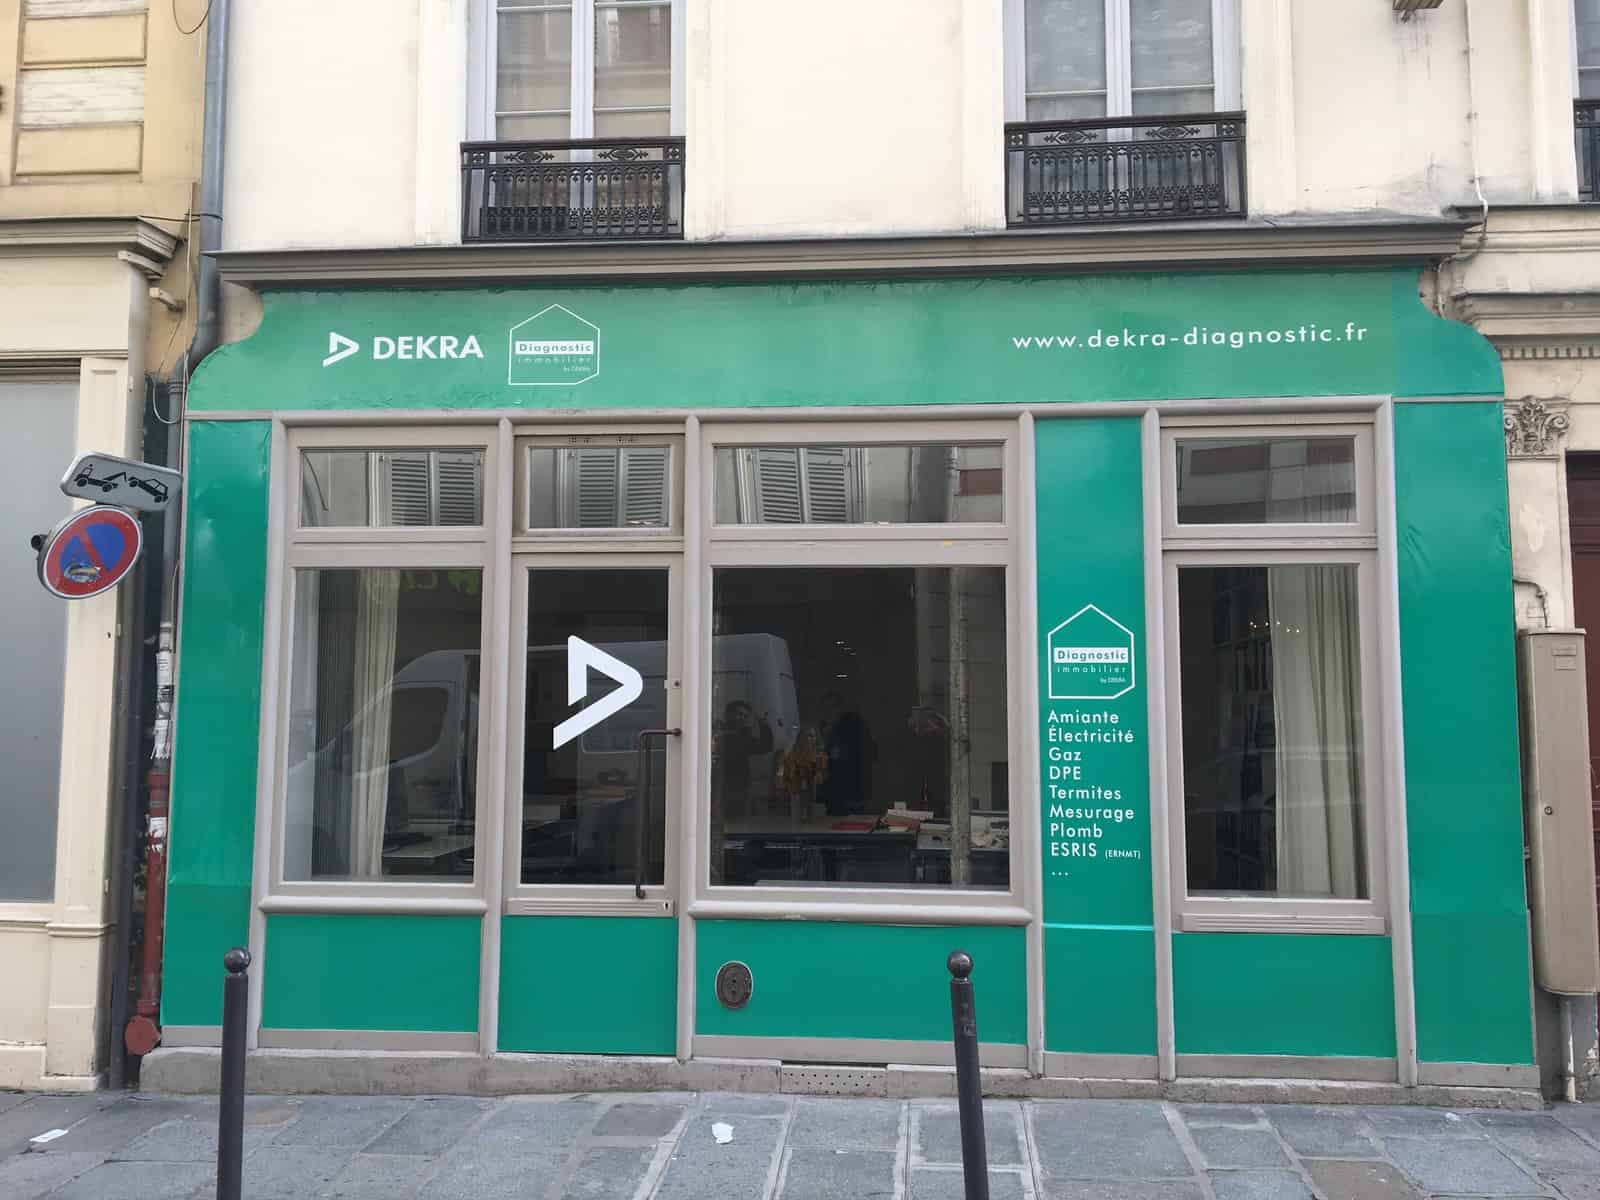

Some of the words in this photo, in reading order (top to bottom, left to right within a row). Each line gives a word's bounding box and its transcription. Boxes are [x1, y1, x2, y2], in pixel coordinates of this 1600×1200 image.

[1012, 322, 1368, 349] www.dekra-diagnostic.fr
[372, 335, 484, 360] DEKRA
[519, 343, 592, 353] Diagnostic
[1057, 650, 1128, 662] Diagnostic
[1057, 664, 1126, 673] immobilier
[1048, 709, 1119, 724] Amiante
[1049, 725, 1134, 743] Électricité
[1049, 747, 1082, 761] Gaz
[1050, 766, 1081, 780] DPE
[1049, 785, 1121, 800] Termites
[1050, 804, 1135, 823] Mesurage
[1051, 823, 1103, 838] Plomb
[1051, 842, 1097, 857] ESRIS
